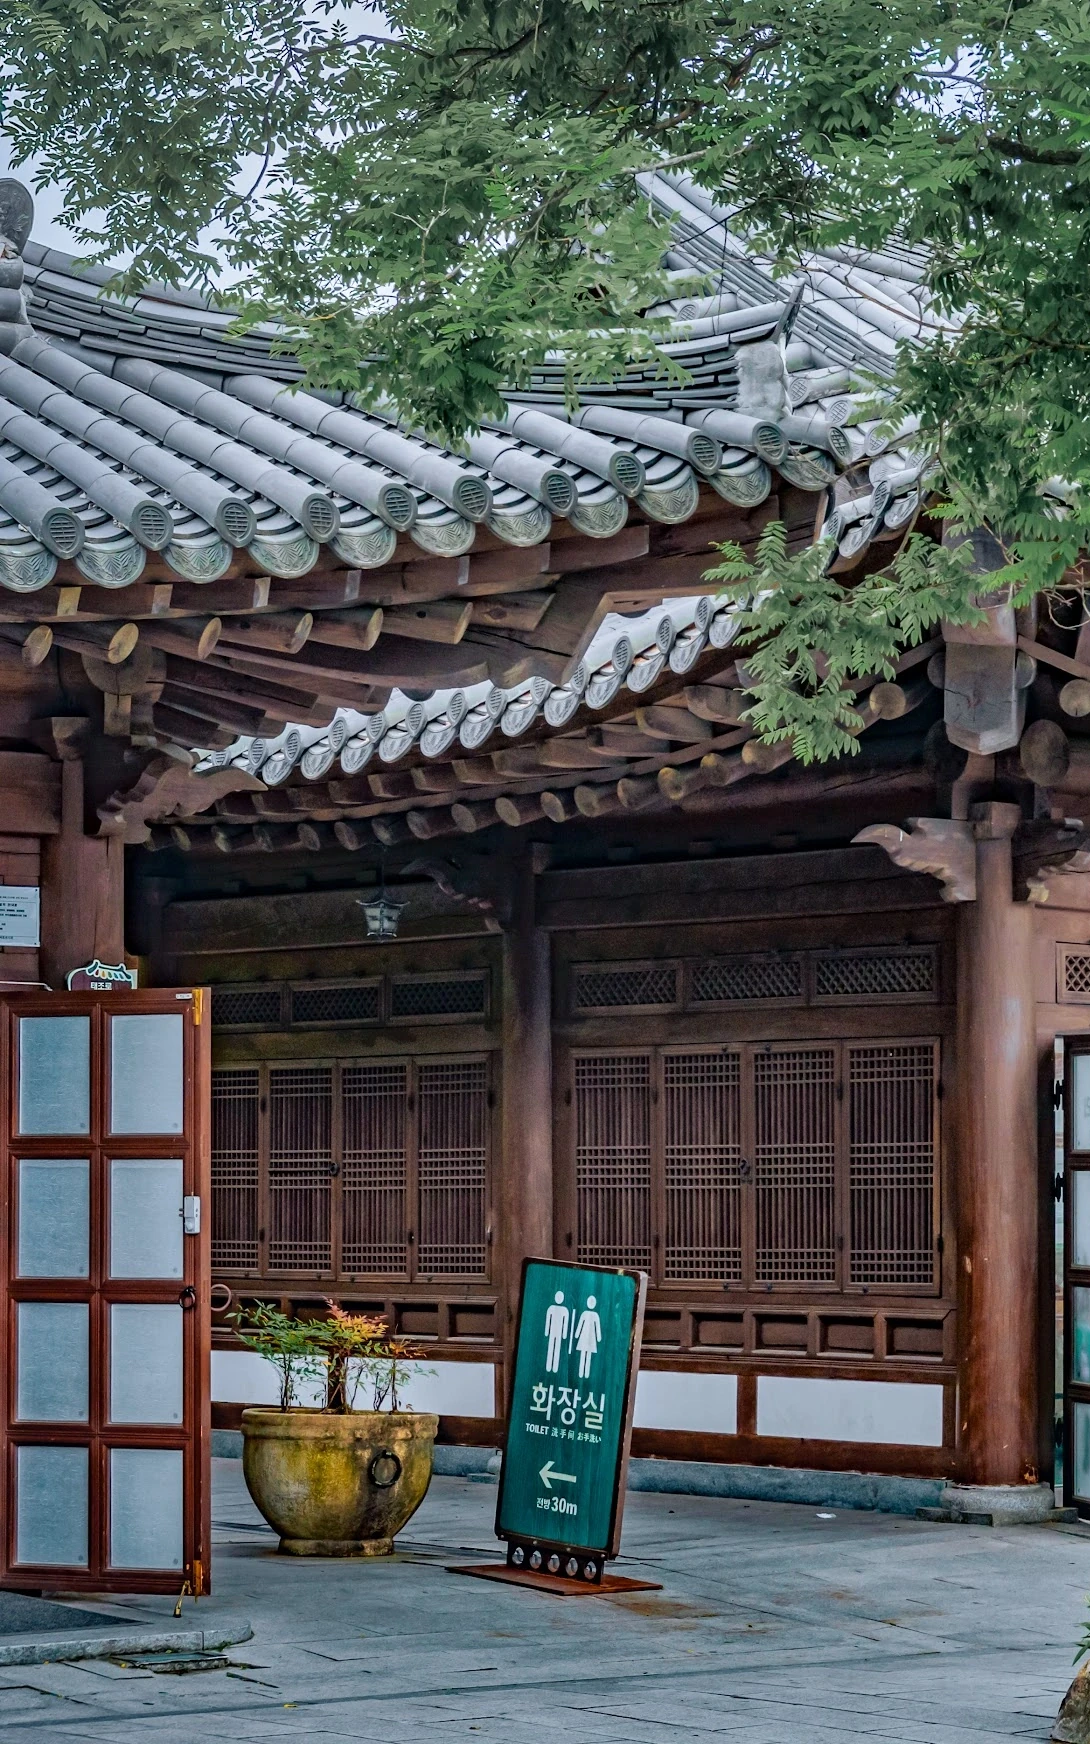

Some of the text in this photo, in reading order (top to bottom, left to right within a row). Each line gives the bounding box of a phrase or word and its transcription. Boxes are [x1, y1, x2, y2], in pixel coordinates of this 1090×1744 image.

[529, 1381, 606, 1431] 화장실
[525, 1422, 550, 1436] TOILET
[576, 1431, 602, 1444] お手洗い
